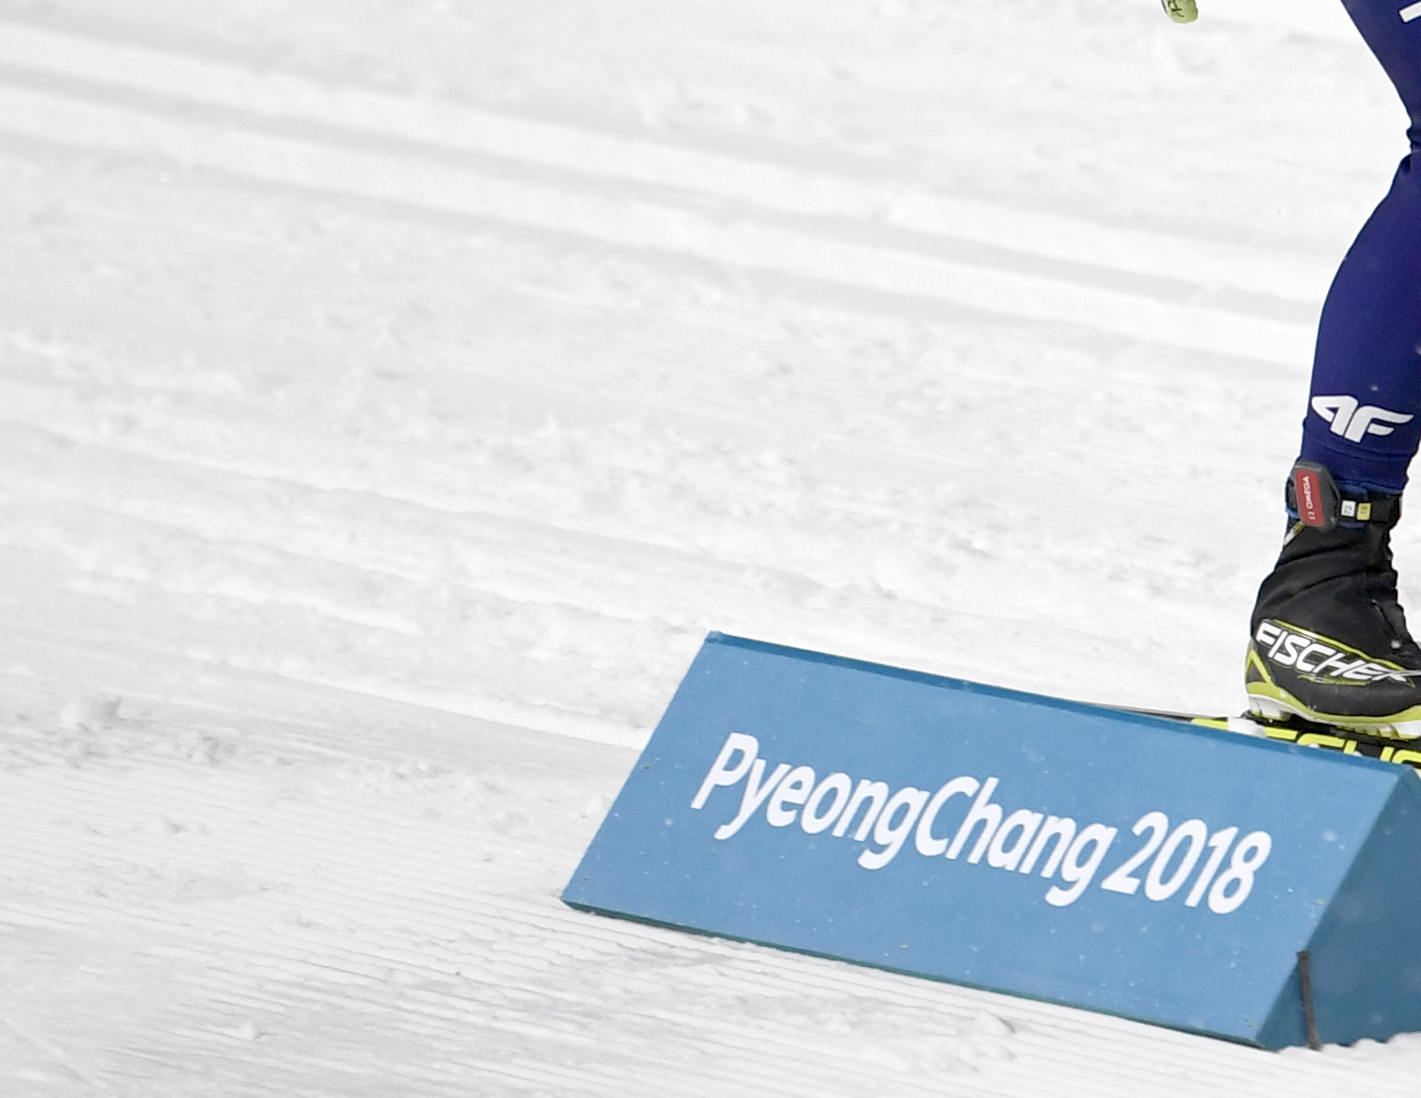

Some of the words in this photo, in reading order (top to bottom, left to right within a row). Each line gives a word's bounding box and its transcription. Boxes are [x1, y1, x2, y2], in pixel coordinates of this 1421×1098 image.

[1302, 475, 1314, 510] OMEGA
[1255, 622, 1420, 683] FISCHER
[690, 732, 1119, 907] PyeongChang
[1101, 811, 1273, 915] 2018
